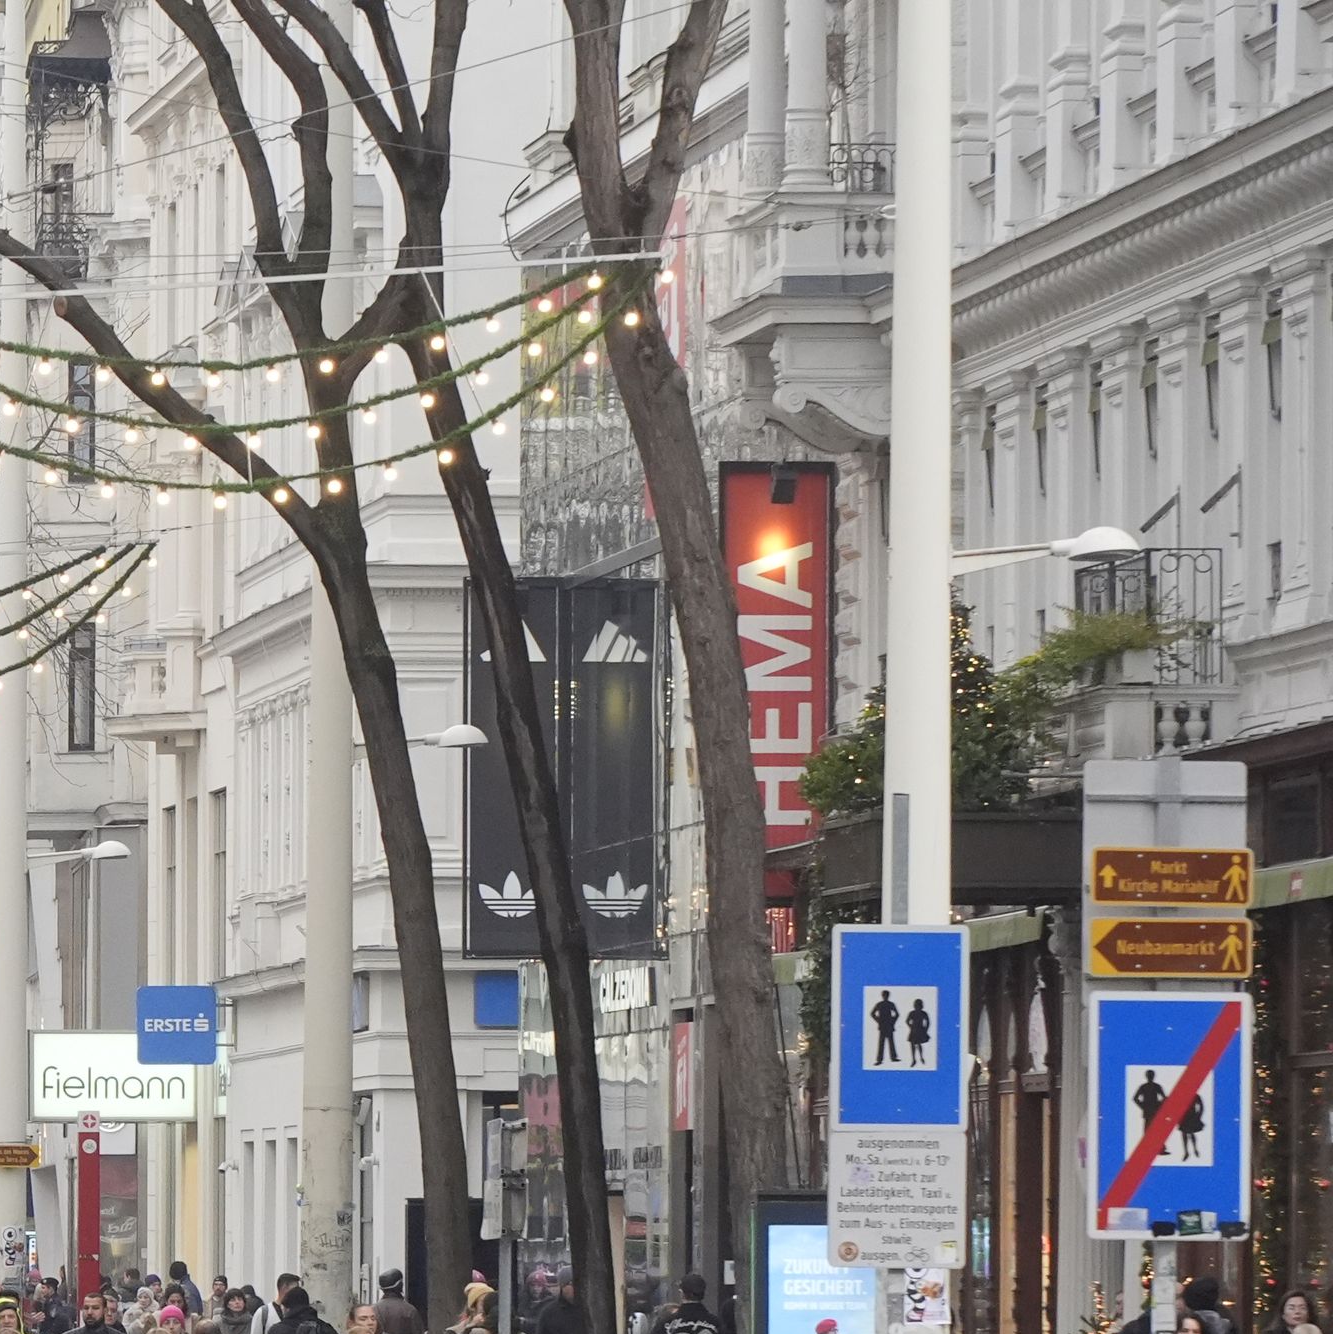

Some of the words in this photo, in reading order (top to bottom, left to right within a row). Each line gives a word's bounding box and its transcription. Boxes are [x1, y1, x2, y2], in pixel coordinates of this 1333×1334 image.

[737, 541, 814, 827] HEMA
[1151, 860, 1188, 875] Markt
[144, 1018, 192, 1033] ERSTE
[42, 1065, 186, 1100] fielmann
[856, 1139, 940, 1151] ausgenommen
[877, 1170, 918, 1182] Zufahrt
[920, 1173, 938, 1182] zur
[921, 1187, 943, 1199] Taxi
[836, 1201, 958, 1216] Behindertentransporte
[839, 1220, 862, 1229] zum
[898, 1218, 956, 1232] Einsteigen
[860, 1251, 901, 1263] ausgen.
[784, 1279, 868, 1297] GESICHERT.
